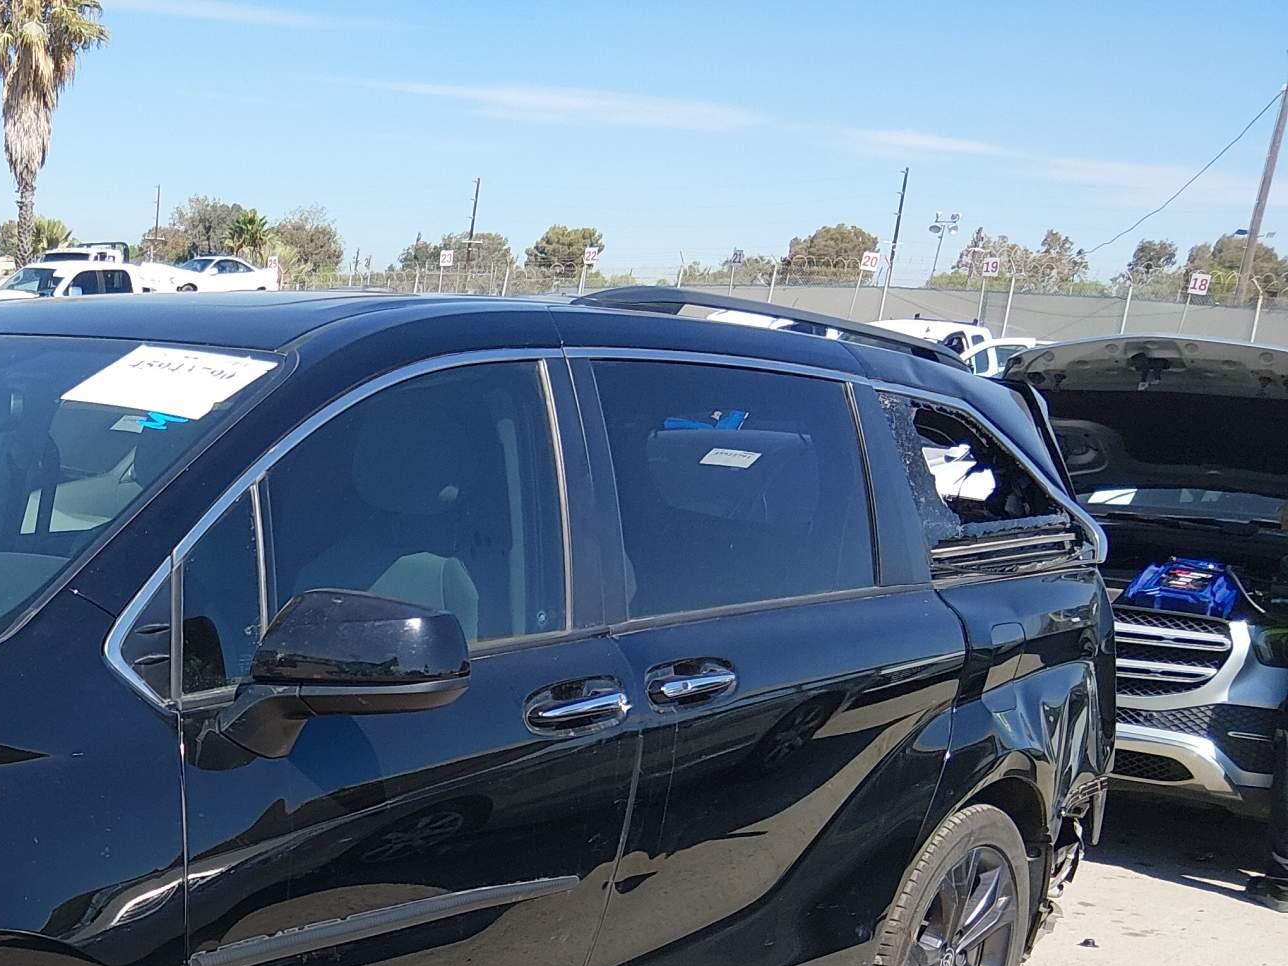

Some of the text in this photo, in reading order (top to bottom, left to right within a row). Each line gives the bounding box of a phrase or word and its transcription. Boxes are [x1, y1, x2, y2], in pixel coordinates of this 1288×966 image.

[441, 253, 453, 263] 23
[585, 250, 598, 261] 22
[732, 252, 743, 264] 21
[862, 255, 879, 268] 20
[983, 261, 999, 273] 19
[1190, 277, 1209, 291] 18
